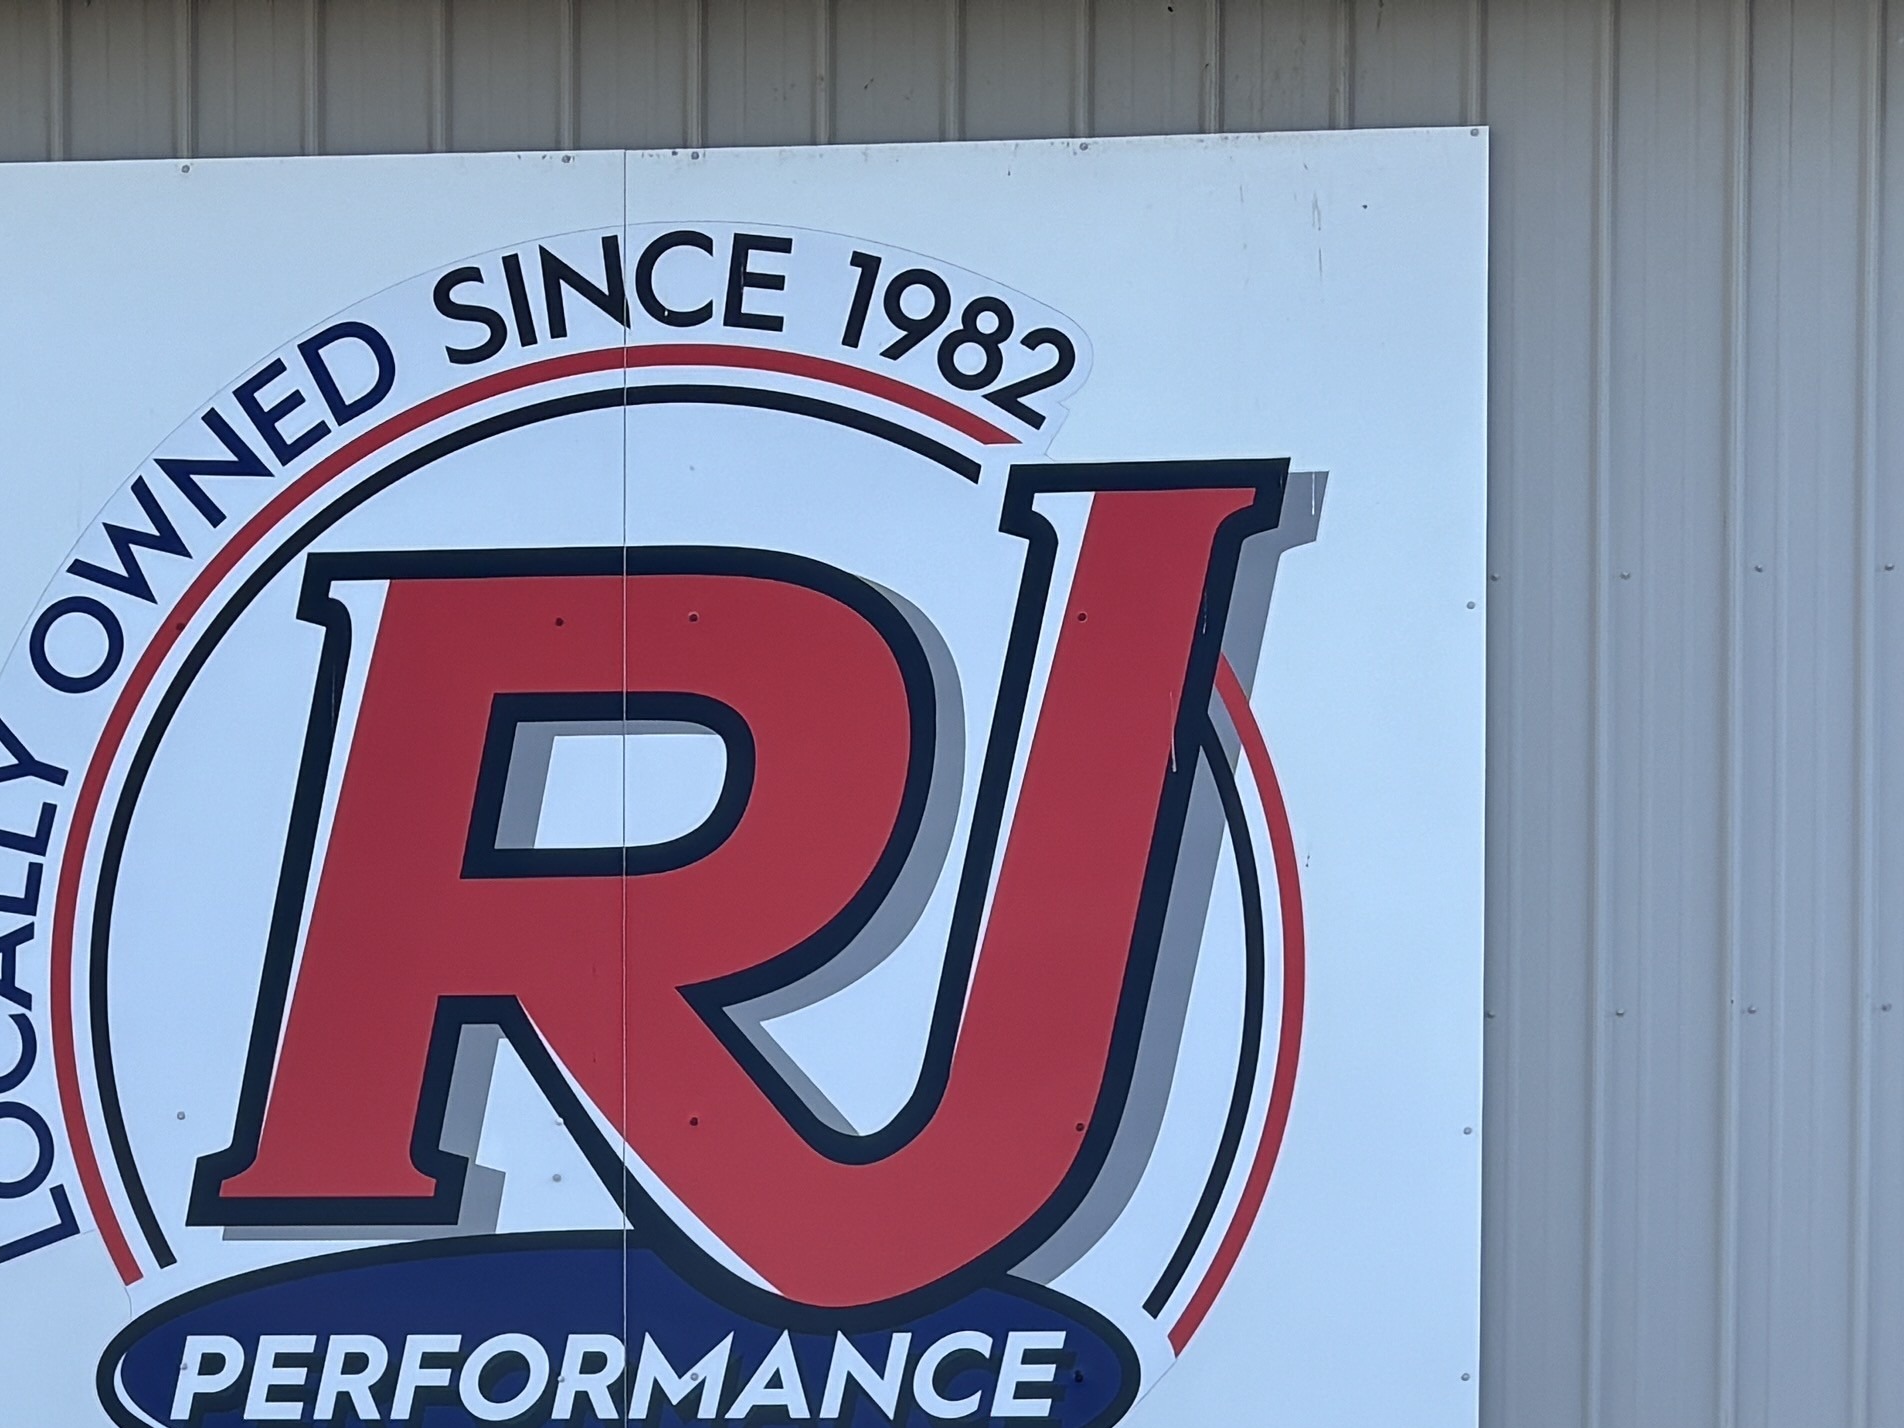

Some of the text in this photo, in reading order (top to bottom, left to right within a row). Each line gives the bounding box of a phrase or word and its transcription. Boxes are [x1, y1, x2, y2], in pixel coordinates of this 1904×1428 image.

[29, 321, 396, 694] OWNED
[432, 230, 794, 366] SINCE
[841, 250, 1076, 431] 1982
[184, 455, 1294, 1336] RJ
[166, 1326, 1067, 1424] PERFORMANCE
